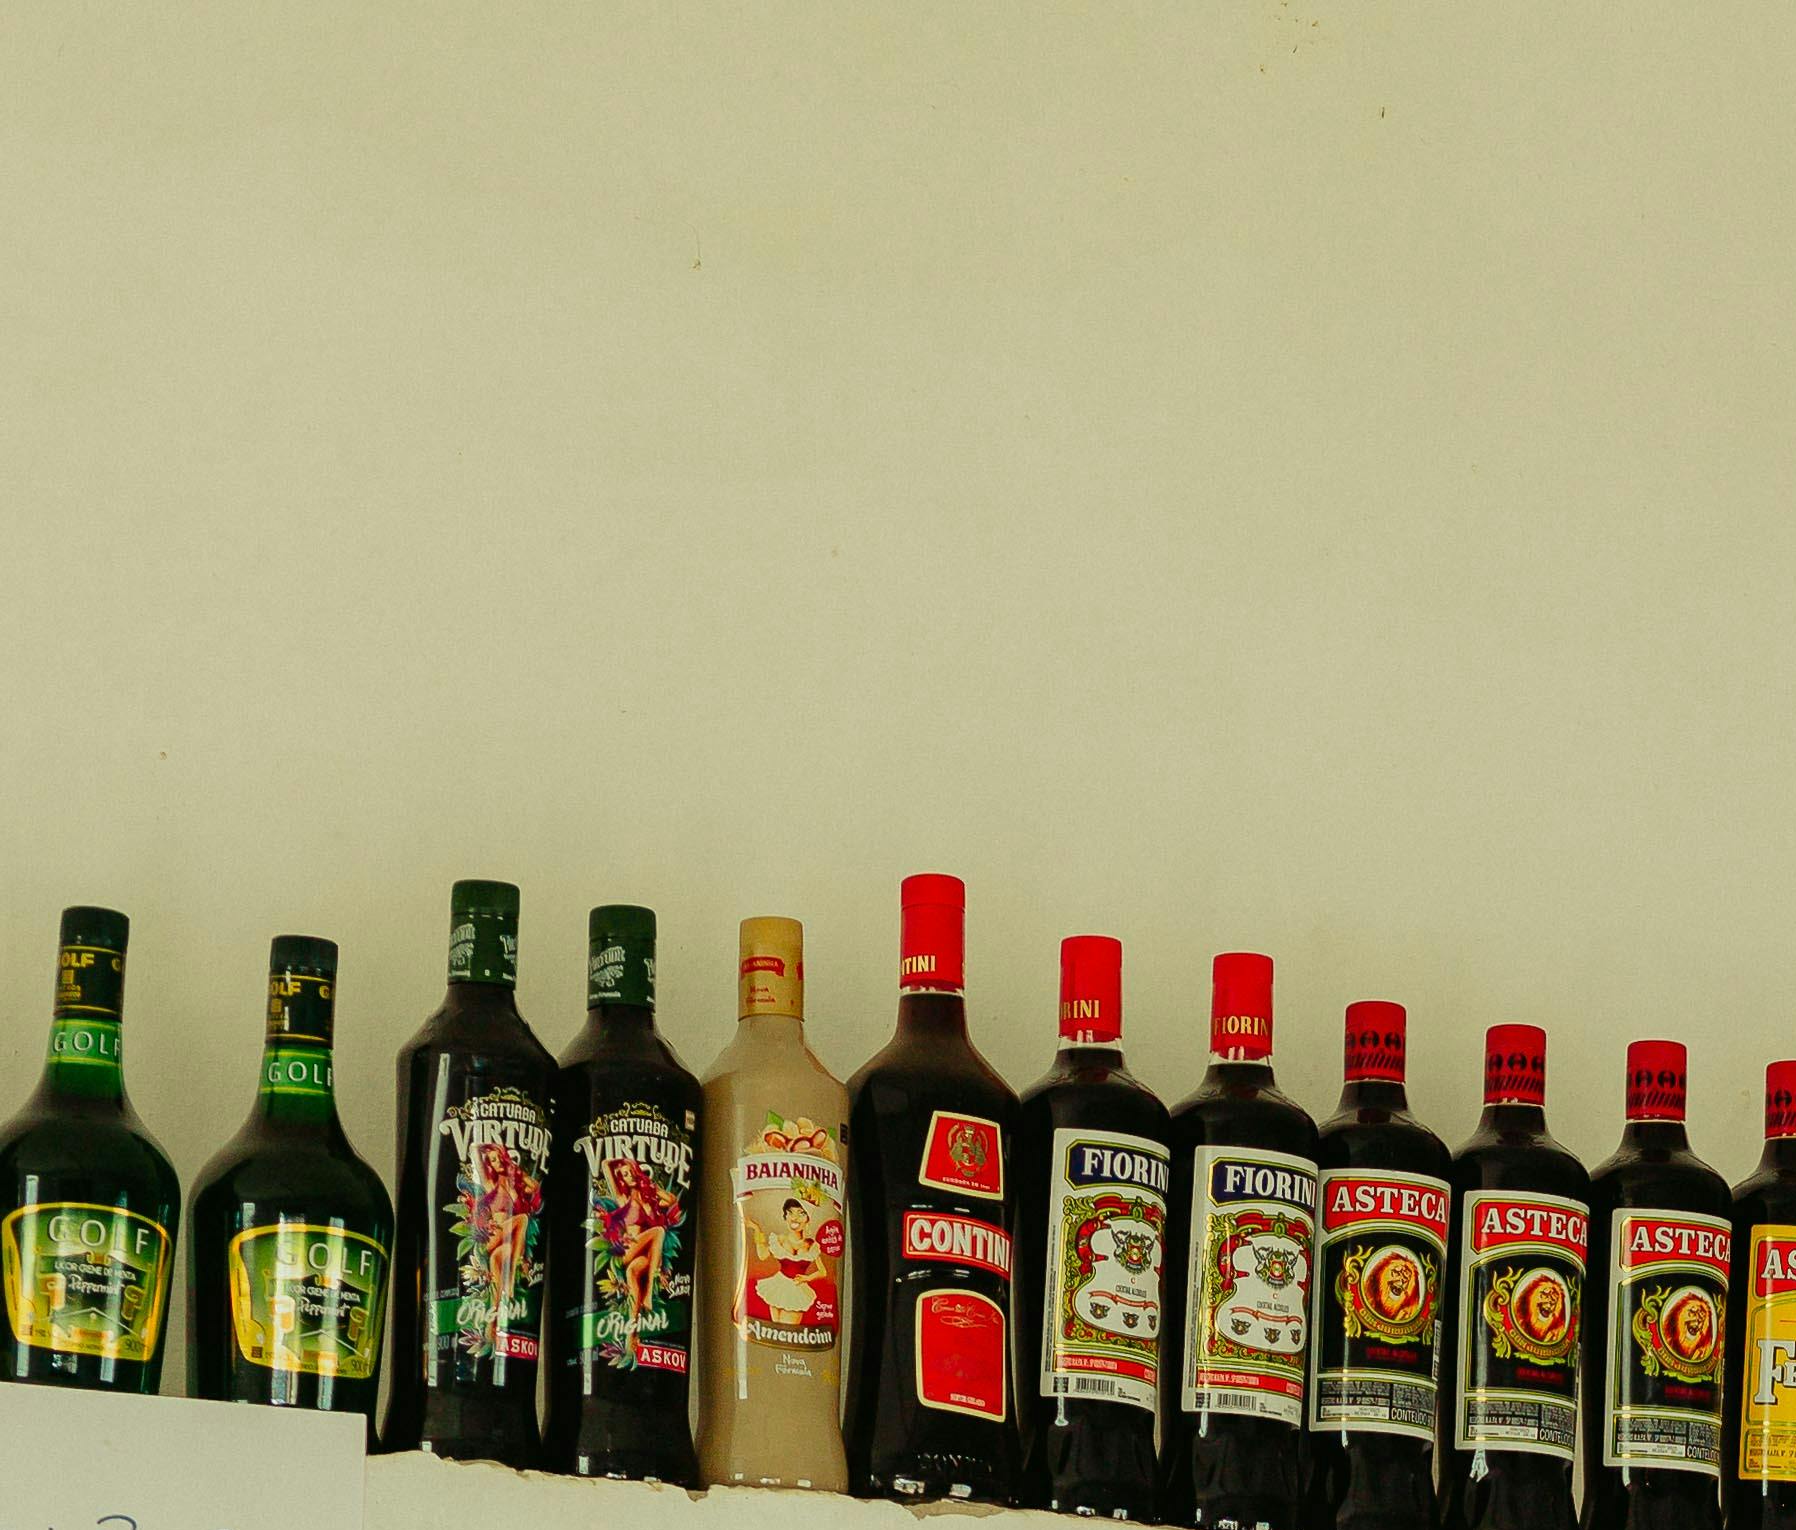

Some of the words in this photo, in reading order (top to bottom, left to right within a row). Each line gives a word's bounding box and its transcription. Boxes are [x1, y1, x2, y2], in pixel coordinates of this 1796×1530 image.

[610, 1117, 669, 1138] CATUABA
[573, 1133, 693, 1189] VIRTUDE
[745, 1162, 839, 1190] BAIANINHA
[1332, 1185, 1447, 1224] ASTECA
[49, 1215, 149, 1255] GOLF
[911, 1218, 1009, 1272] CONTINI
[1481, 1207, 1588, 1247] ASTECA
[278, 1242, 371, 1277] GOLF
[640, 1347, 686, 1369] ASKOV
